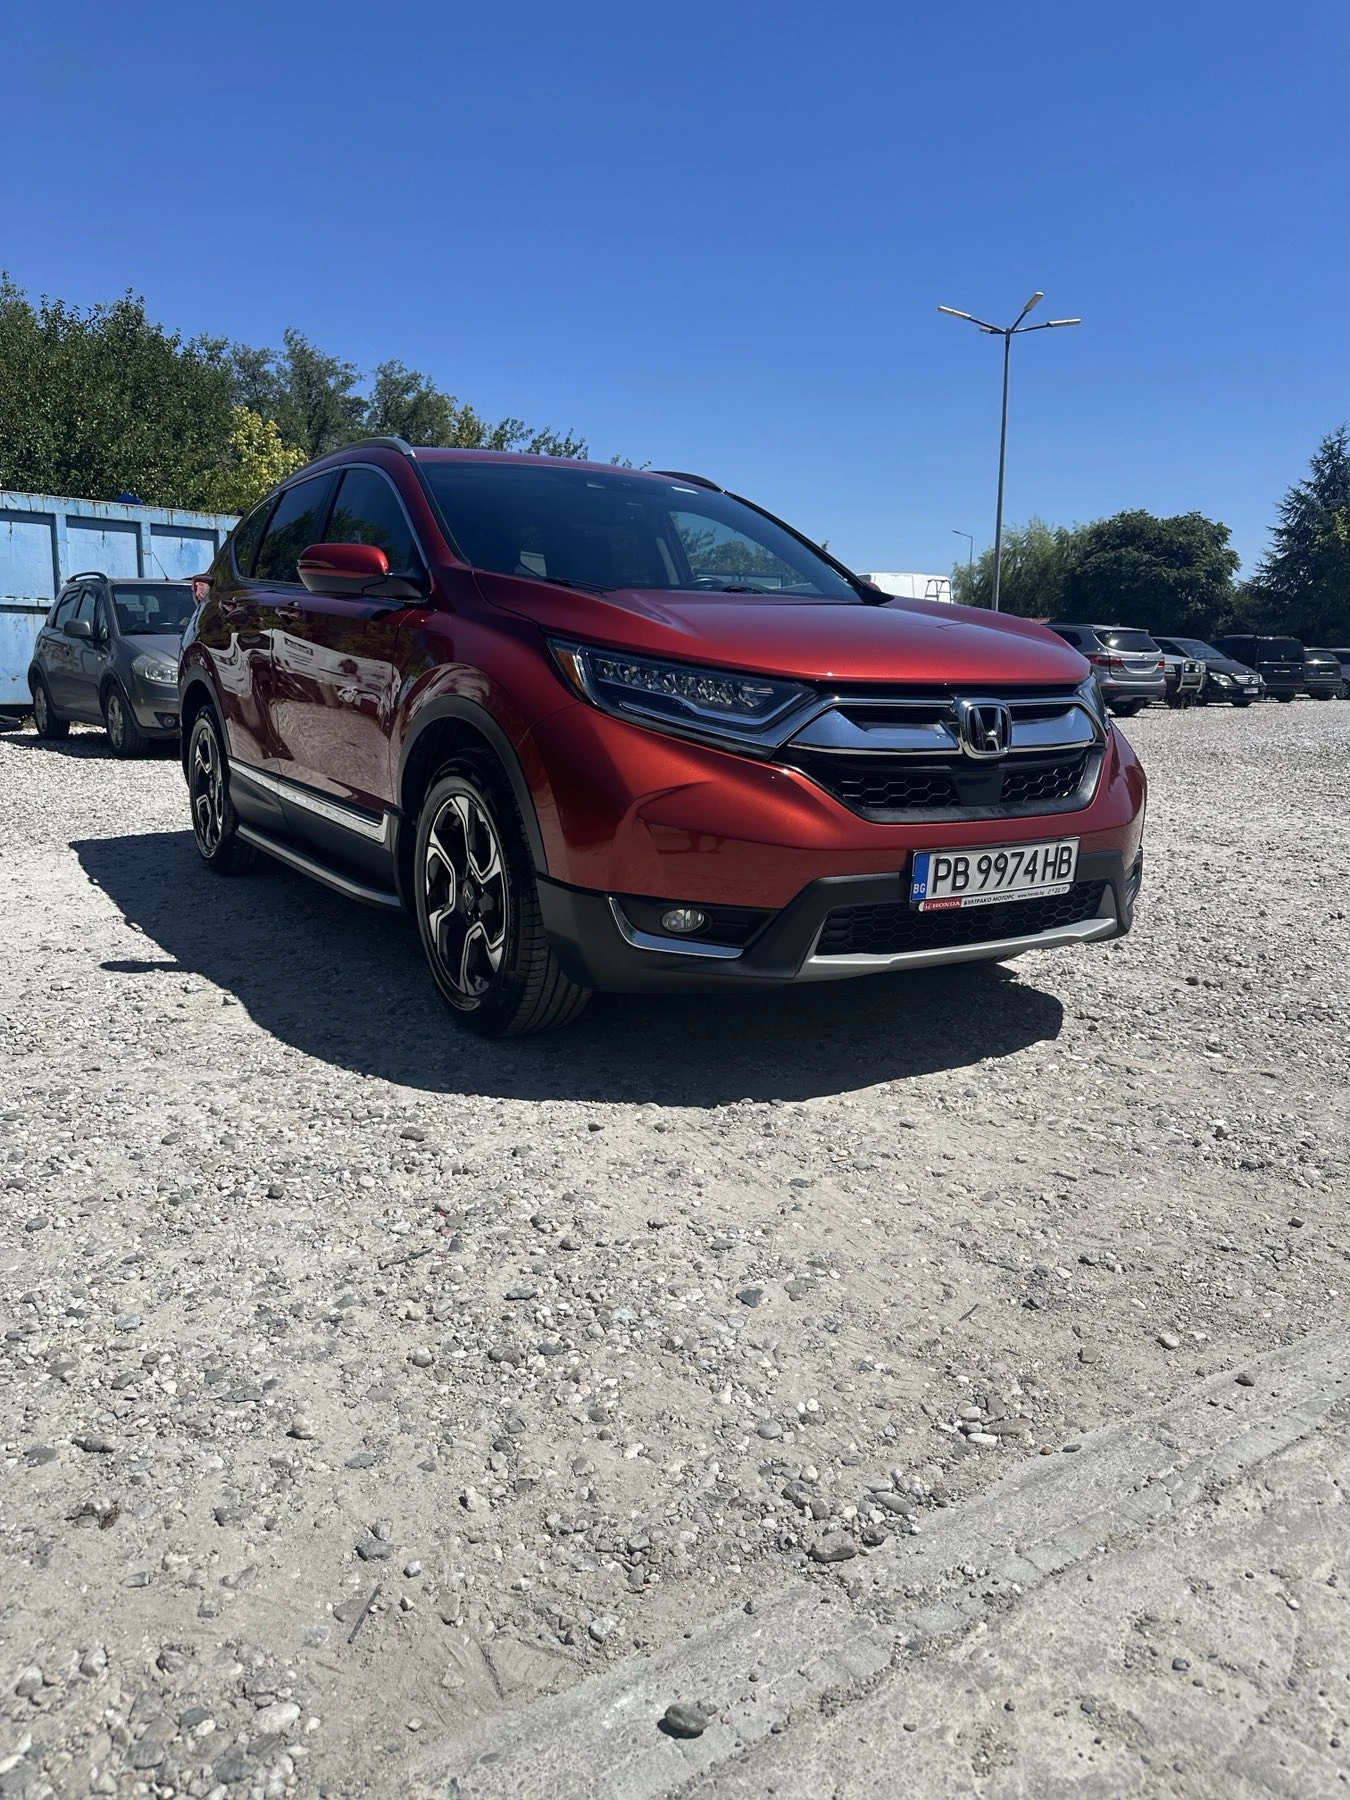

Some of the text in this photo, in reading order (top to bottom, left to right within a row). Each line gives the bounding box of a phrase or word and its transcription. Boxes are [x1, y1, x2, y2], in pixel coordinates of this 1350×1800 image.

[932, 845, 1073, 894] PB 9974 HB
[913, 883, 926, 894] BG
[932, 900, 960, 909] HONDA
